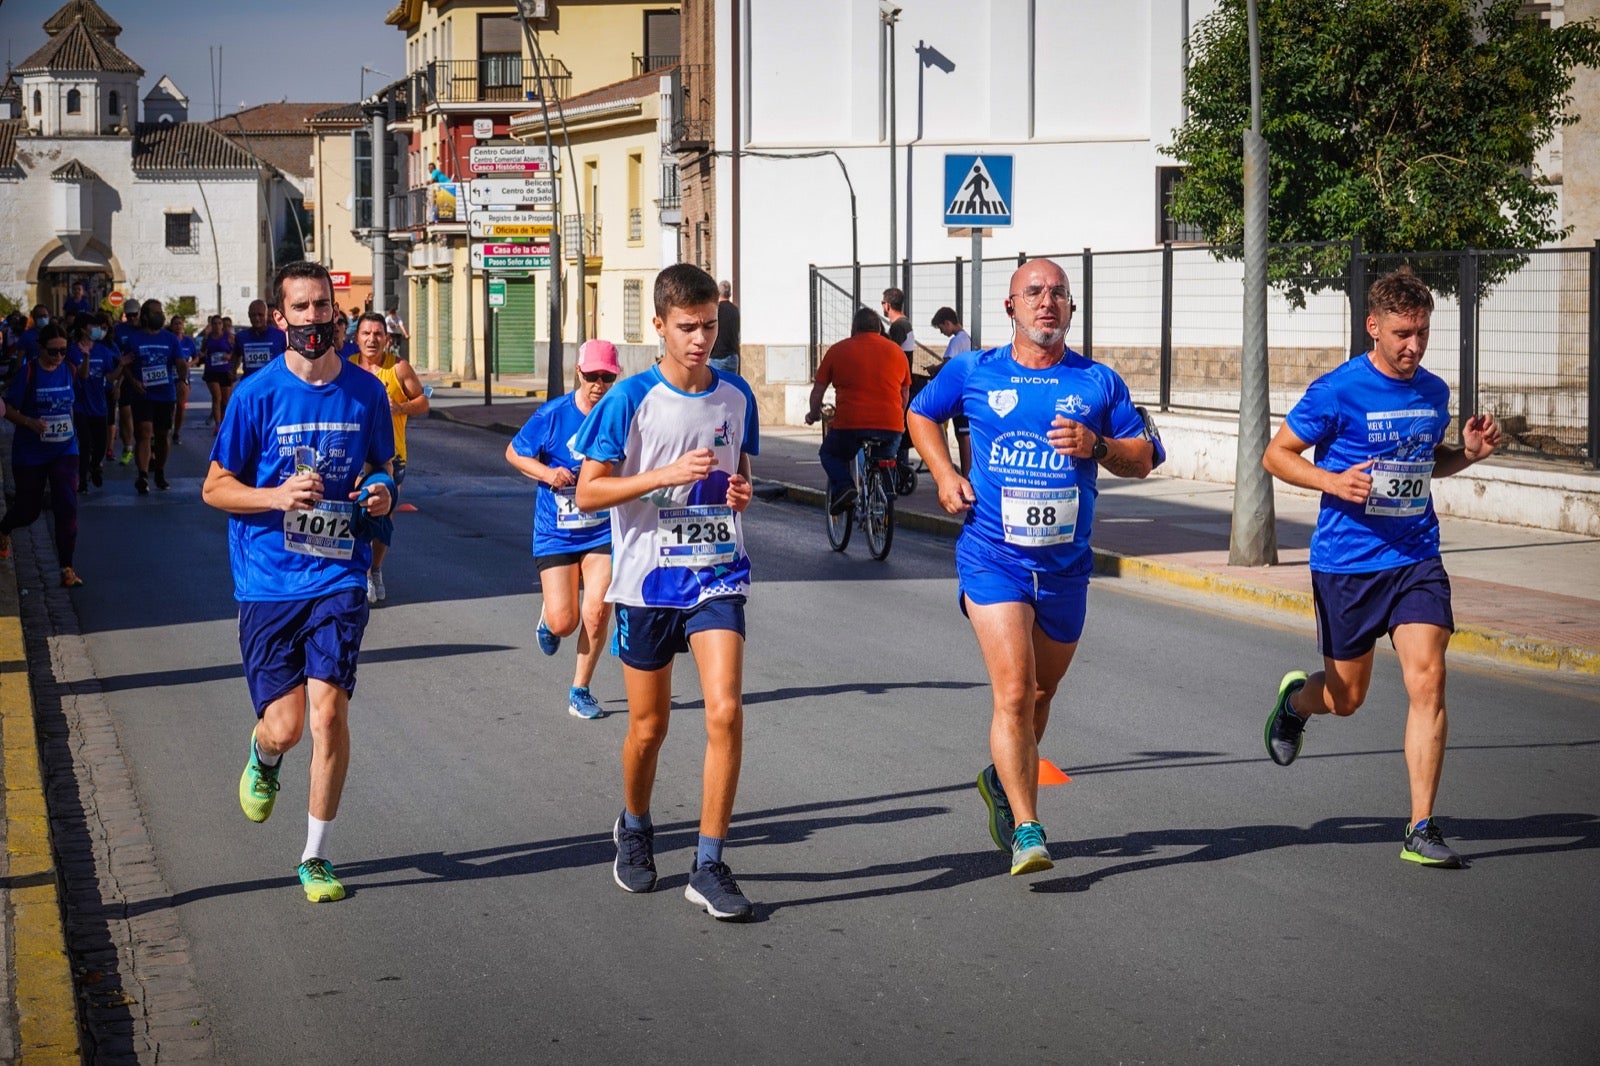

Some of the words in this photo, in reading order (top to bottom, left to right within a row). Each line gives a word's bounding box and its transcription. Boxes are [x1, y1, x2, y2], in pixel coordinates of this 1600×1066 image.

[488, 214, 512, 222] Registro
[528, 214, 553, 222] Propieda
[495, 226, 519, 234] Oficina
[493, 246, 511, 254] Casa
[512, 246, 521, 254] de
[523, 246, 530, 254] la
[248, 353, 268, 361] 1040
[1010, 376, 1059, 385] GIVOVA
[50, 422, 68, 433] 125
[1367, 421, 1384, 431] VUELVE
[277, 435, 294, 445] VUELVE
[295, 434, 303, 443] LA
[995, 430, 1016, 443] PINTOR
[1368, 432, 1386, 443] ESTELA
[988, 441, 1066, 471] EMILIO
[1030, 471, 1067, 479] DECORACIONES
[1386, 478, 1424, 498] 320
[1030, 490, 1040, 498] AZUL
[1026, 506, 1057, 526] 88
[296, 513, 351, 538] 1012
[671, 522, 731, 544] 1238
[620, 608, 630, 651] FILA
